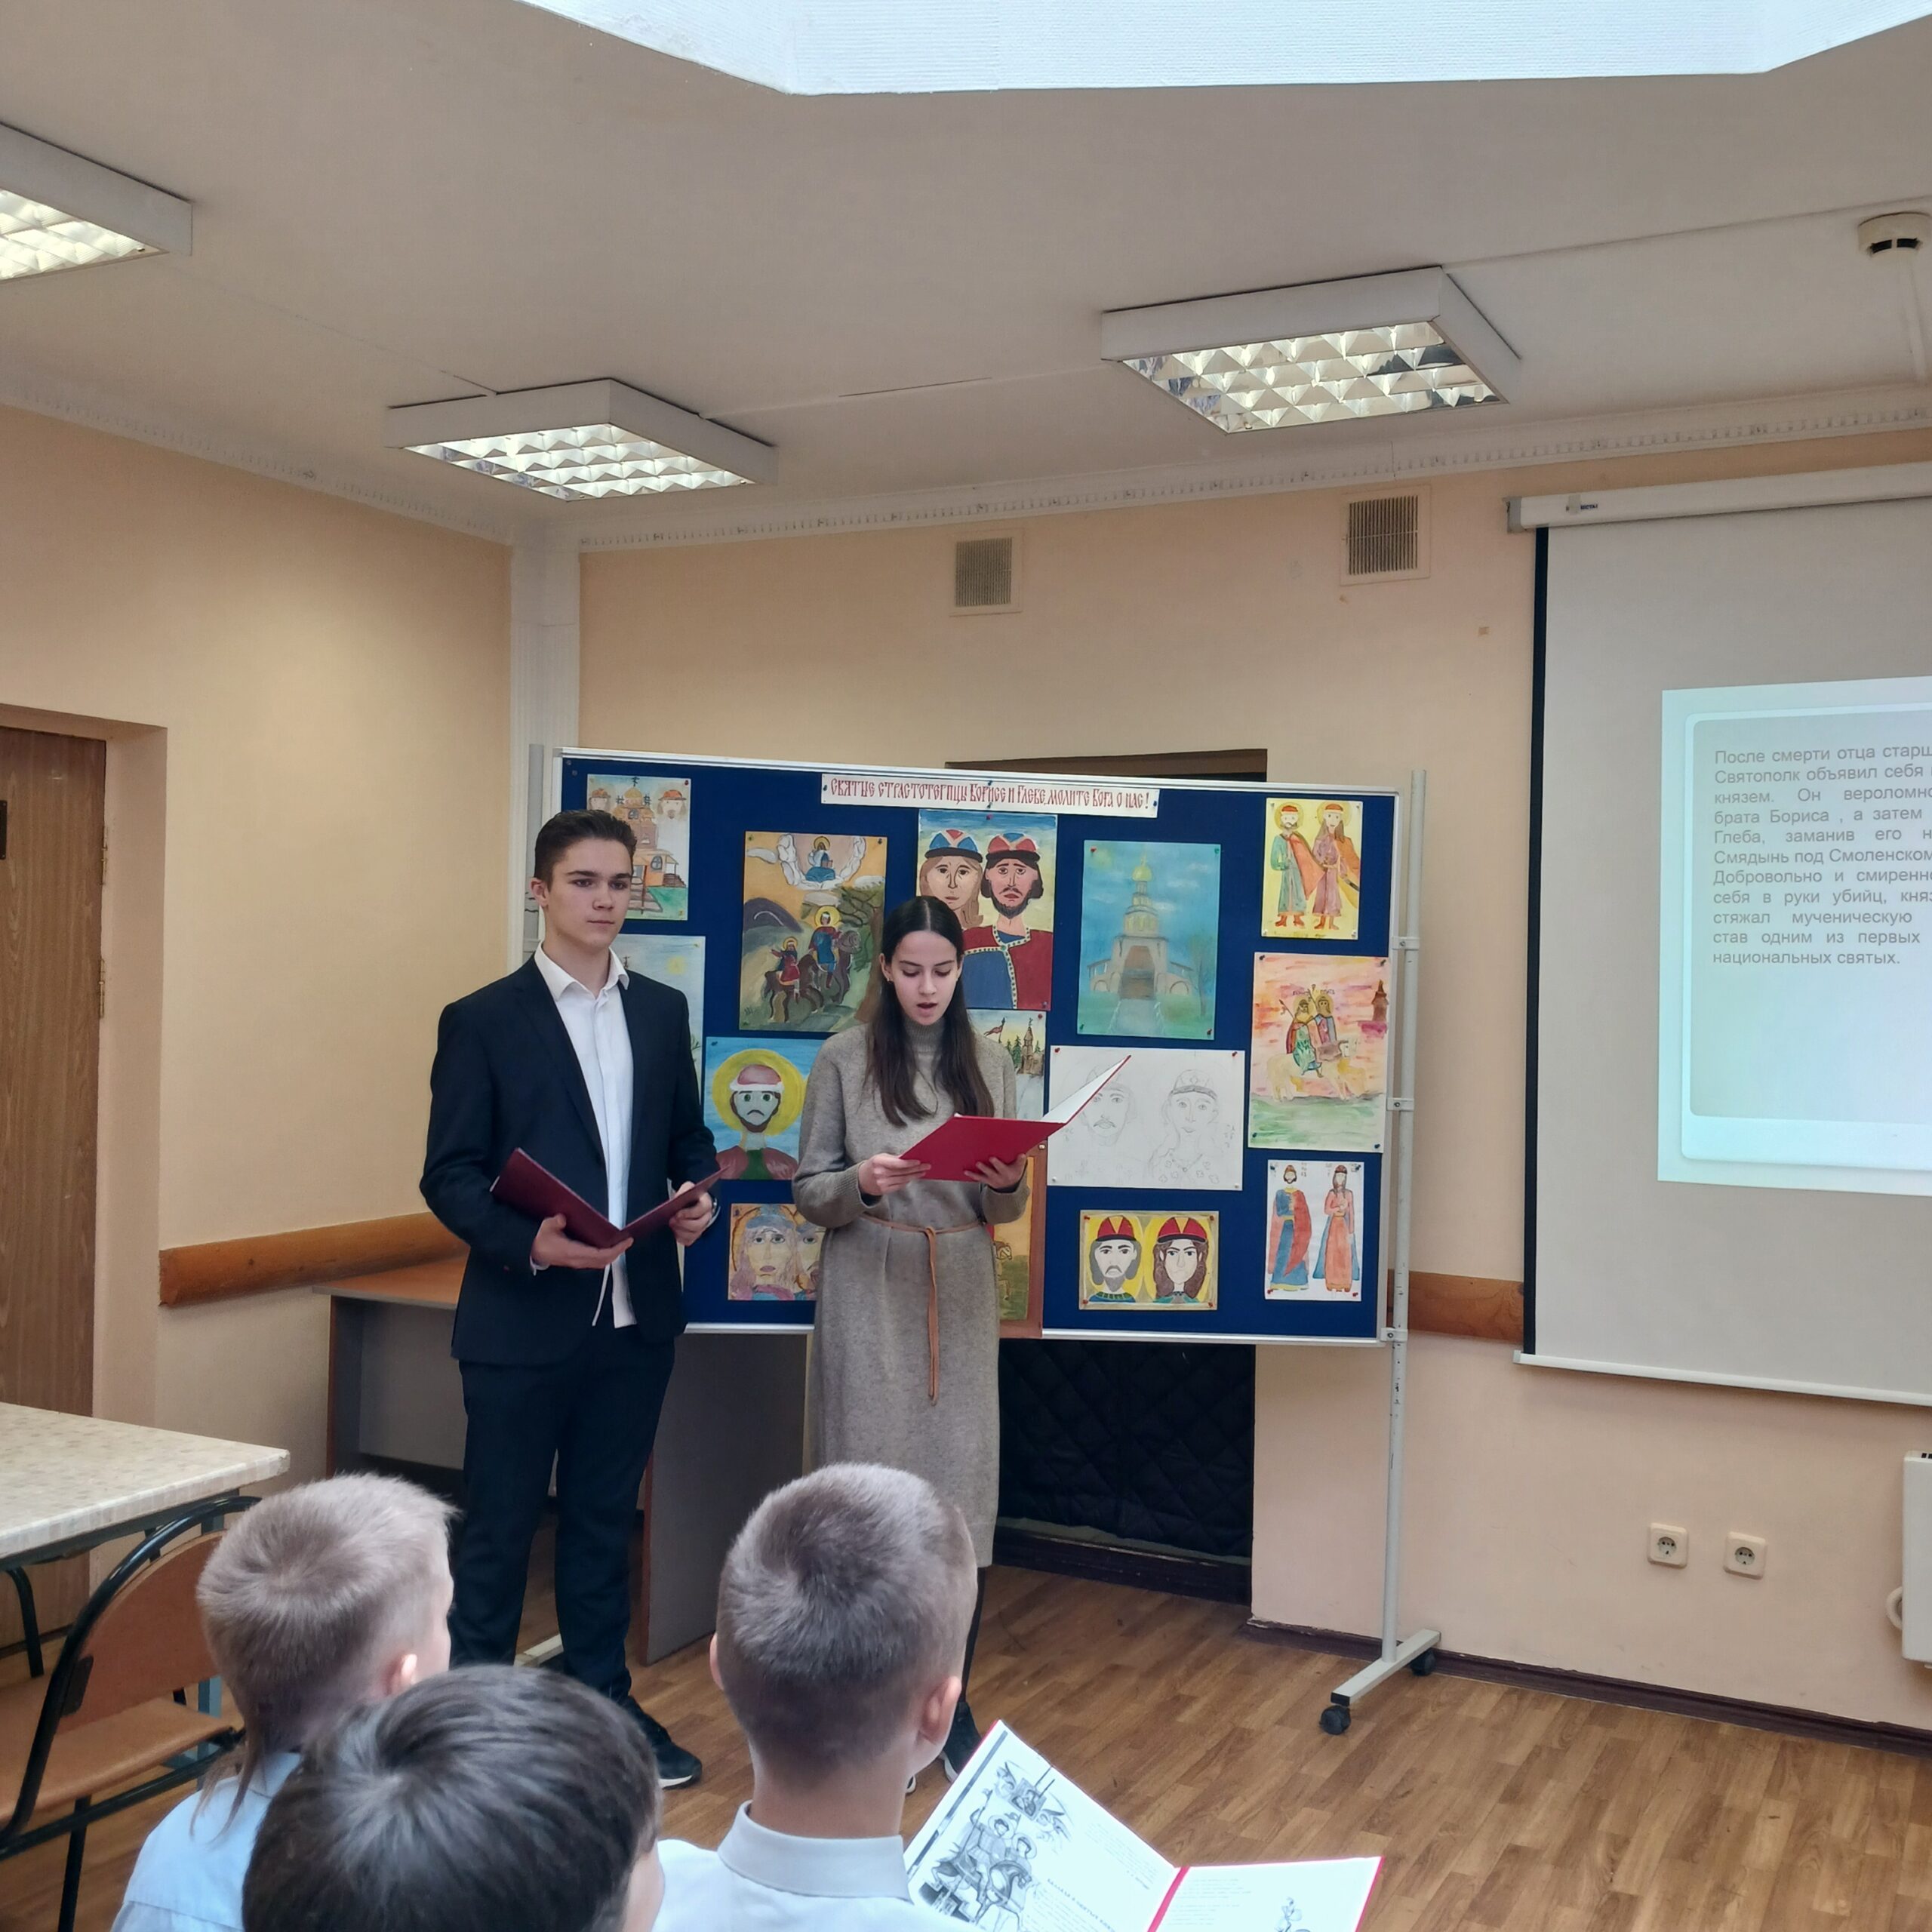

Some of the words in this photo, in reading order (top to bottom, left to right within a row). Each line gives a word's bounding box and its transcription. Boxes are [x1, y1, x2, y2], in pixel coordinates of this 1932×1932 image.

[1715, 750, 1765, 764] После
[1772, 750, 1830, 764] смерти
[1837, 748, 1875, 761] отца
[1715, 770, 1800, 784] Святополк
[1807, 766, 1877, 781] объявил
[1884, 763, 1923, 779] себя
[1714, 792, 1774, 804] князем.
[1798, 788, 1821, 802] Он
[1714, 811, 1760, 828] брата
[1770, 809, 1829, 826] Бориса
[1854, 810, 1863, 822] а
[1873, 809, 1922, 821] затем
[1715, 829, 1765, 844] Глеба,
[1786, 830, 1855, 843] заманив
[1875, 829, 1902, 841] его
[1714, 851, 1789, 866] Смядынь
[1795, 852, 1824, 866] под
[1713, 869, 1823, 887] Добровольно
[1835, 872, 1844, 882] и
[1857, 871, 1932, 885] смиренн
[1713, 890, 1749, 904] себя
[1763, 893, 1771, 904] в
[1784, 893, 1820, 907] руки
[1832, 888, 1887, 906] убийц,
[1713, 913, 1770, 924] стяжал
[1792, 912, 1912, 928] мученическую
[1713, 933, 1748, 944] став
[1761, 933, 1812, 946] одним
[1826, 933, 1844, 944] из
[1858, 933, 1920, 947] первых
[1713, 953, 1832, 966] национальных
[1837, 953, 1900, 964] святых.
